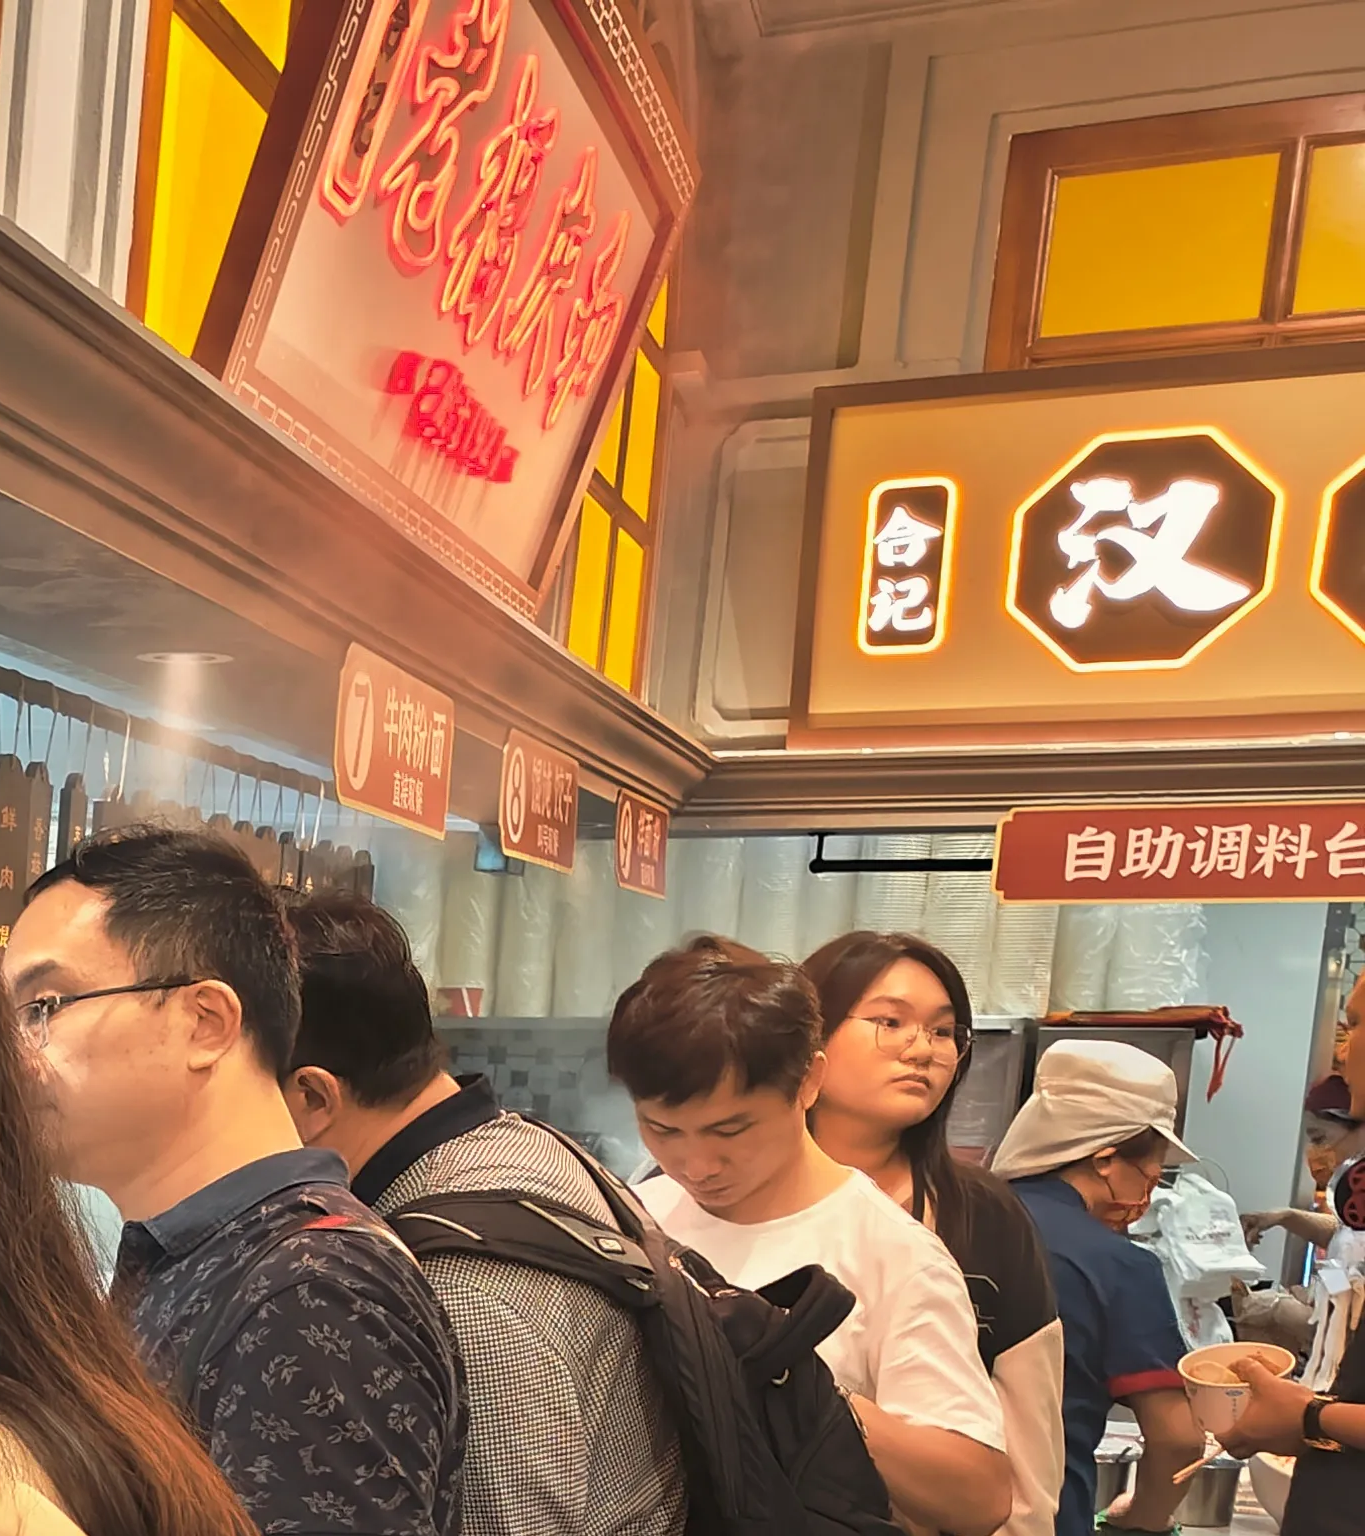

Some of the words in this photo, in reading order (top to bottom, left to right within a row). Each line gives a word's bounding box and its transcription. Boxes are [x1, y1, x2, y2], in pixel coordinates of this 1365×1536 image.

[868, 506, 942, 632] 合记
[1049, 478, 1251, 629] 汉
[1064, 822, 1365, 882] 自助调料台
